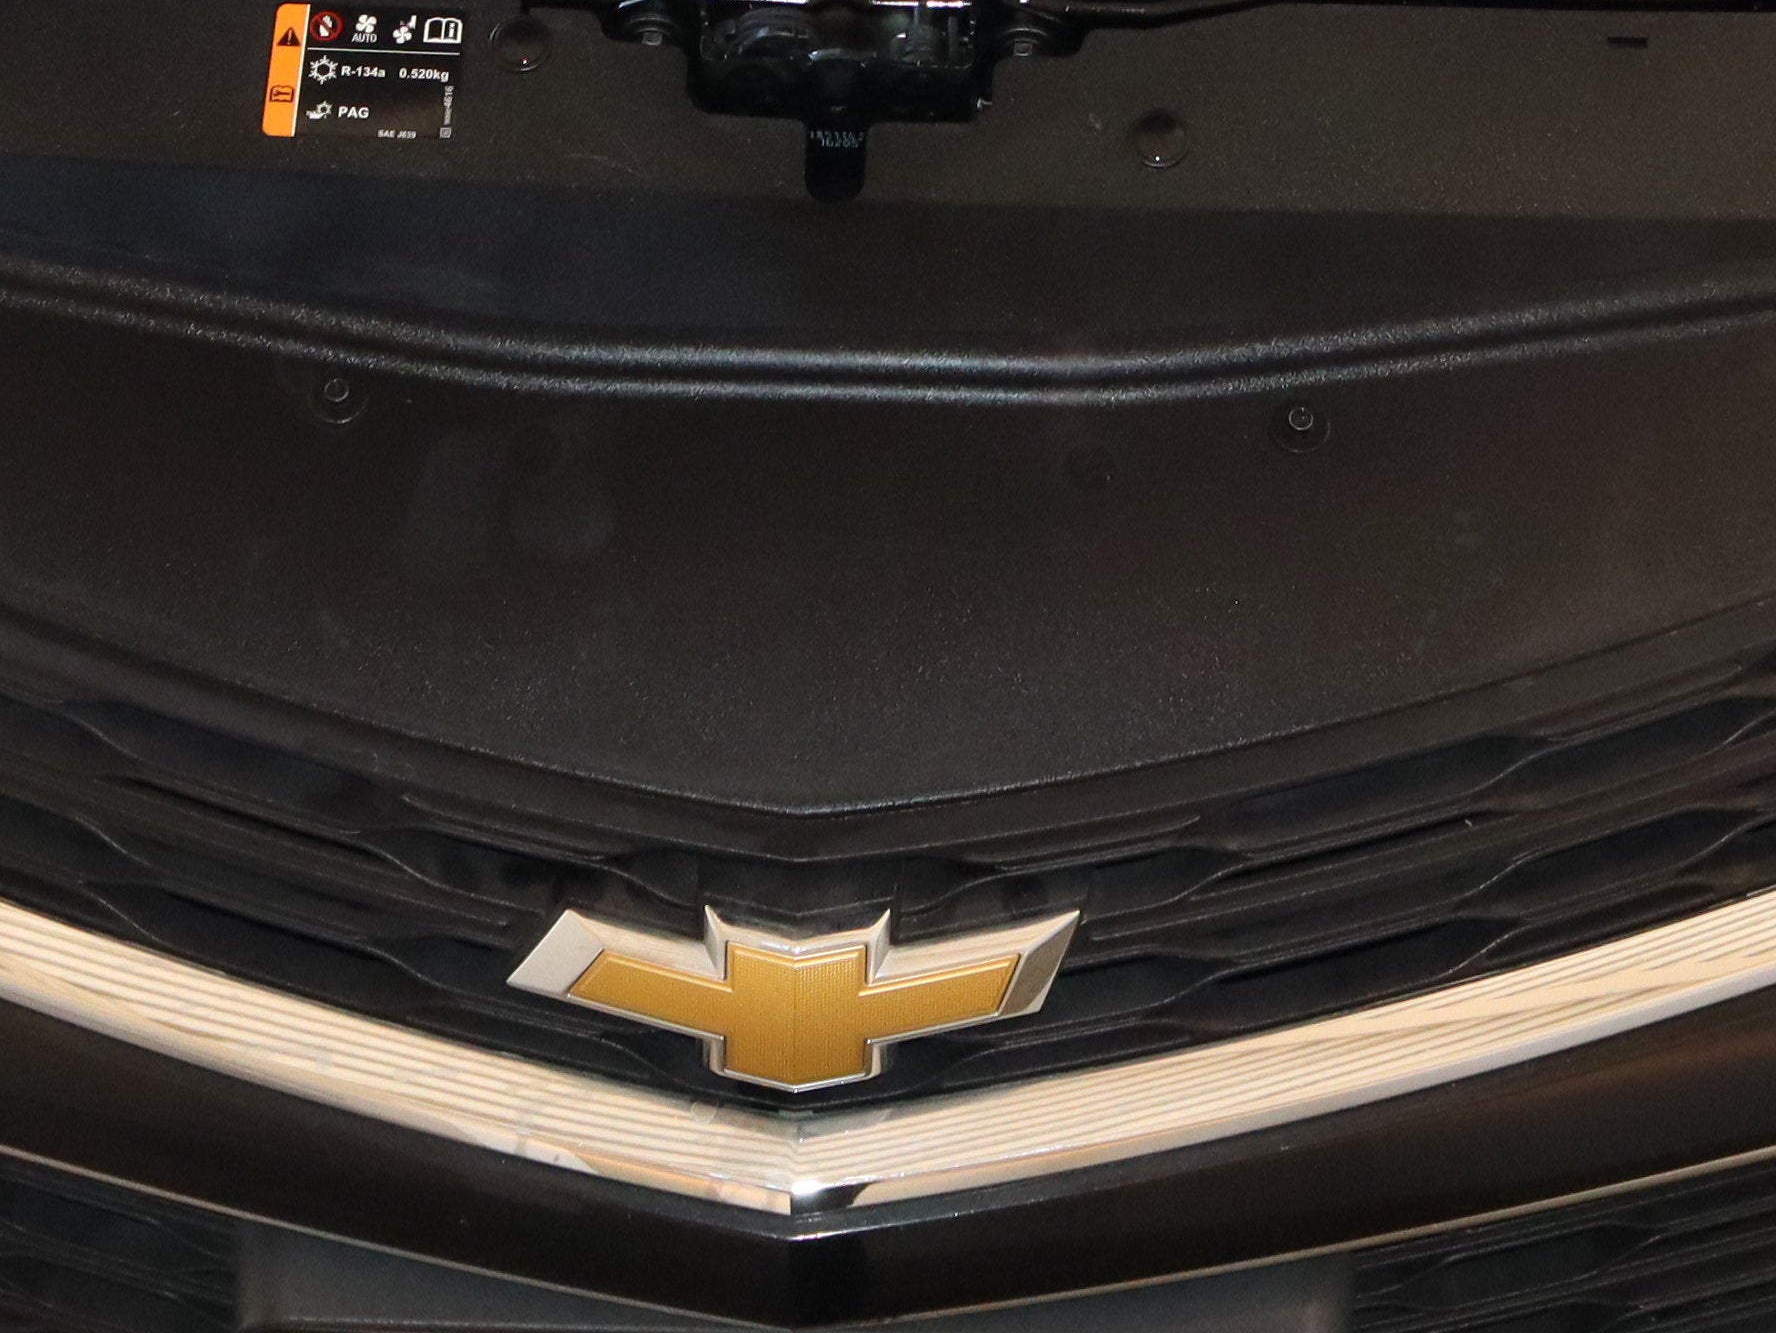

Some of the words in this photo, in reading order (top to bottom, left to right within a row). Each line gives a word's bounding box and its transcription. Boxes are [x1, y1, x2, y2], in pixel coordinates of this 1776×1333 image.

[351, 33, 378, 43] AUTO
[340, 65, 386, 78] R-134a
[399, 68, 450, 83] 0.520kg
[337, 106, 370, 119] PAG
